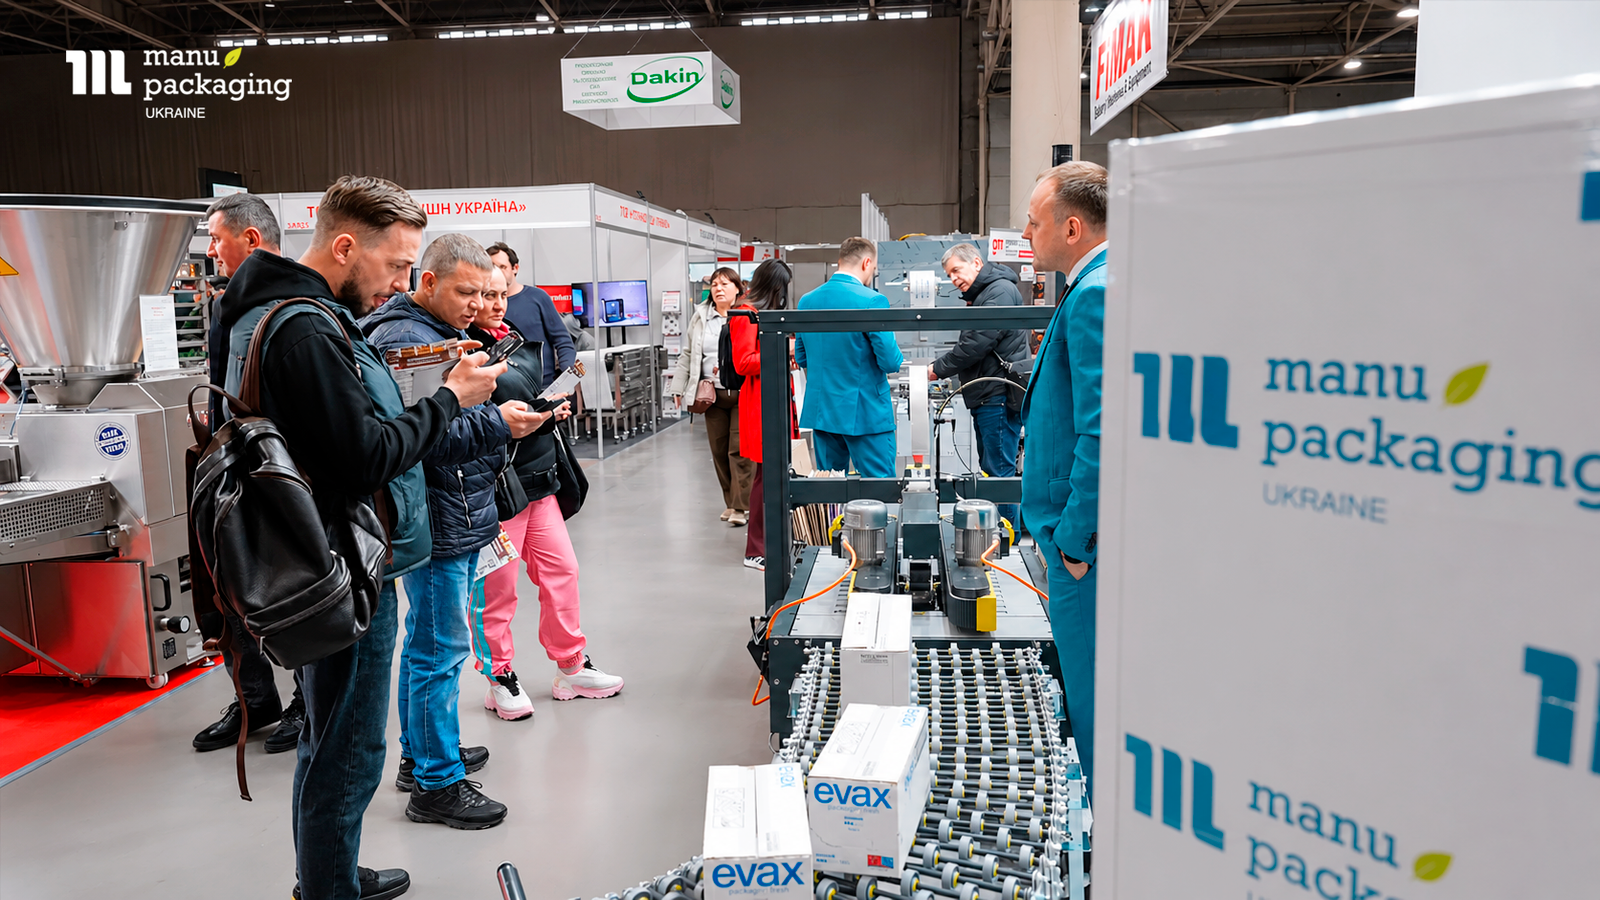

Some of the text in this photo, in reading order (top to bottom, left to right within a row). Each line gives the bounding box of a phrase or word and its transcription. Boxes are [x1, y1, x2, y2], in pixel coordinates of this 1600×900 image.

[631, 68, 699, 86] Dakin
[455, 198, 527, 215] УКРАЇНА»
[1264, 357, 1429, 402] manu
[1261, 417, 1600, 511] packaging
[1262, 482, 1389, 525] UKRAINE
[813, 782, 893, 809] evax
[1247, 780, 1400, 870] manu
[712, 861, 805, 888] evax
[1246, 834, 1403, 900] pack
